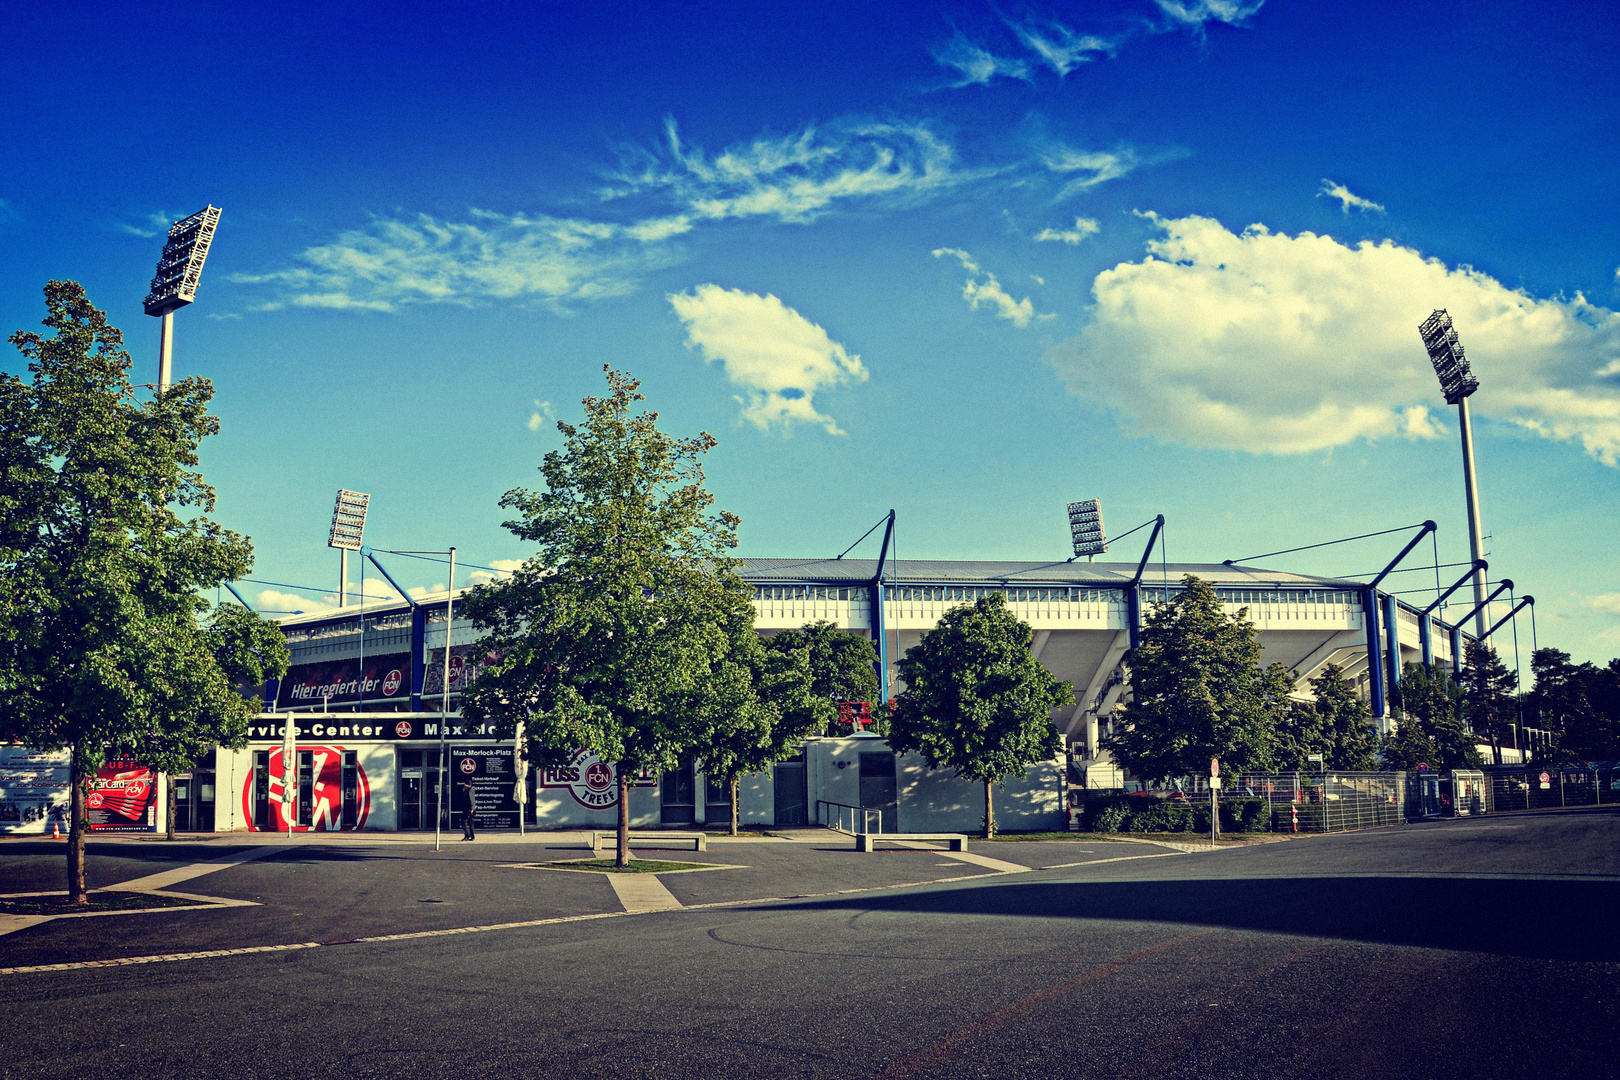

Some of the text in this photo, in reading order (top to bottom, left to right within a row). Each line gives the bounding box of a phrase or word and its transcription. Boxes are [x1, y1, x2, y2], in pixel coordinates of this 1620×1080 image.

[291, 676, 380, 700] Hier regiert der
[383, 680, 400, 690] FCN
[576, 753, 589, 767] MAX
[588, 773, 608, 783] FCN
[126, 786, 143, 794] FCN
[581, 790, 615, 805] TREFF
